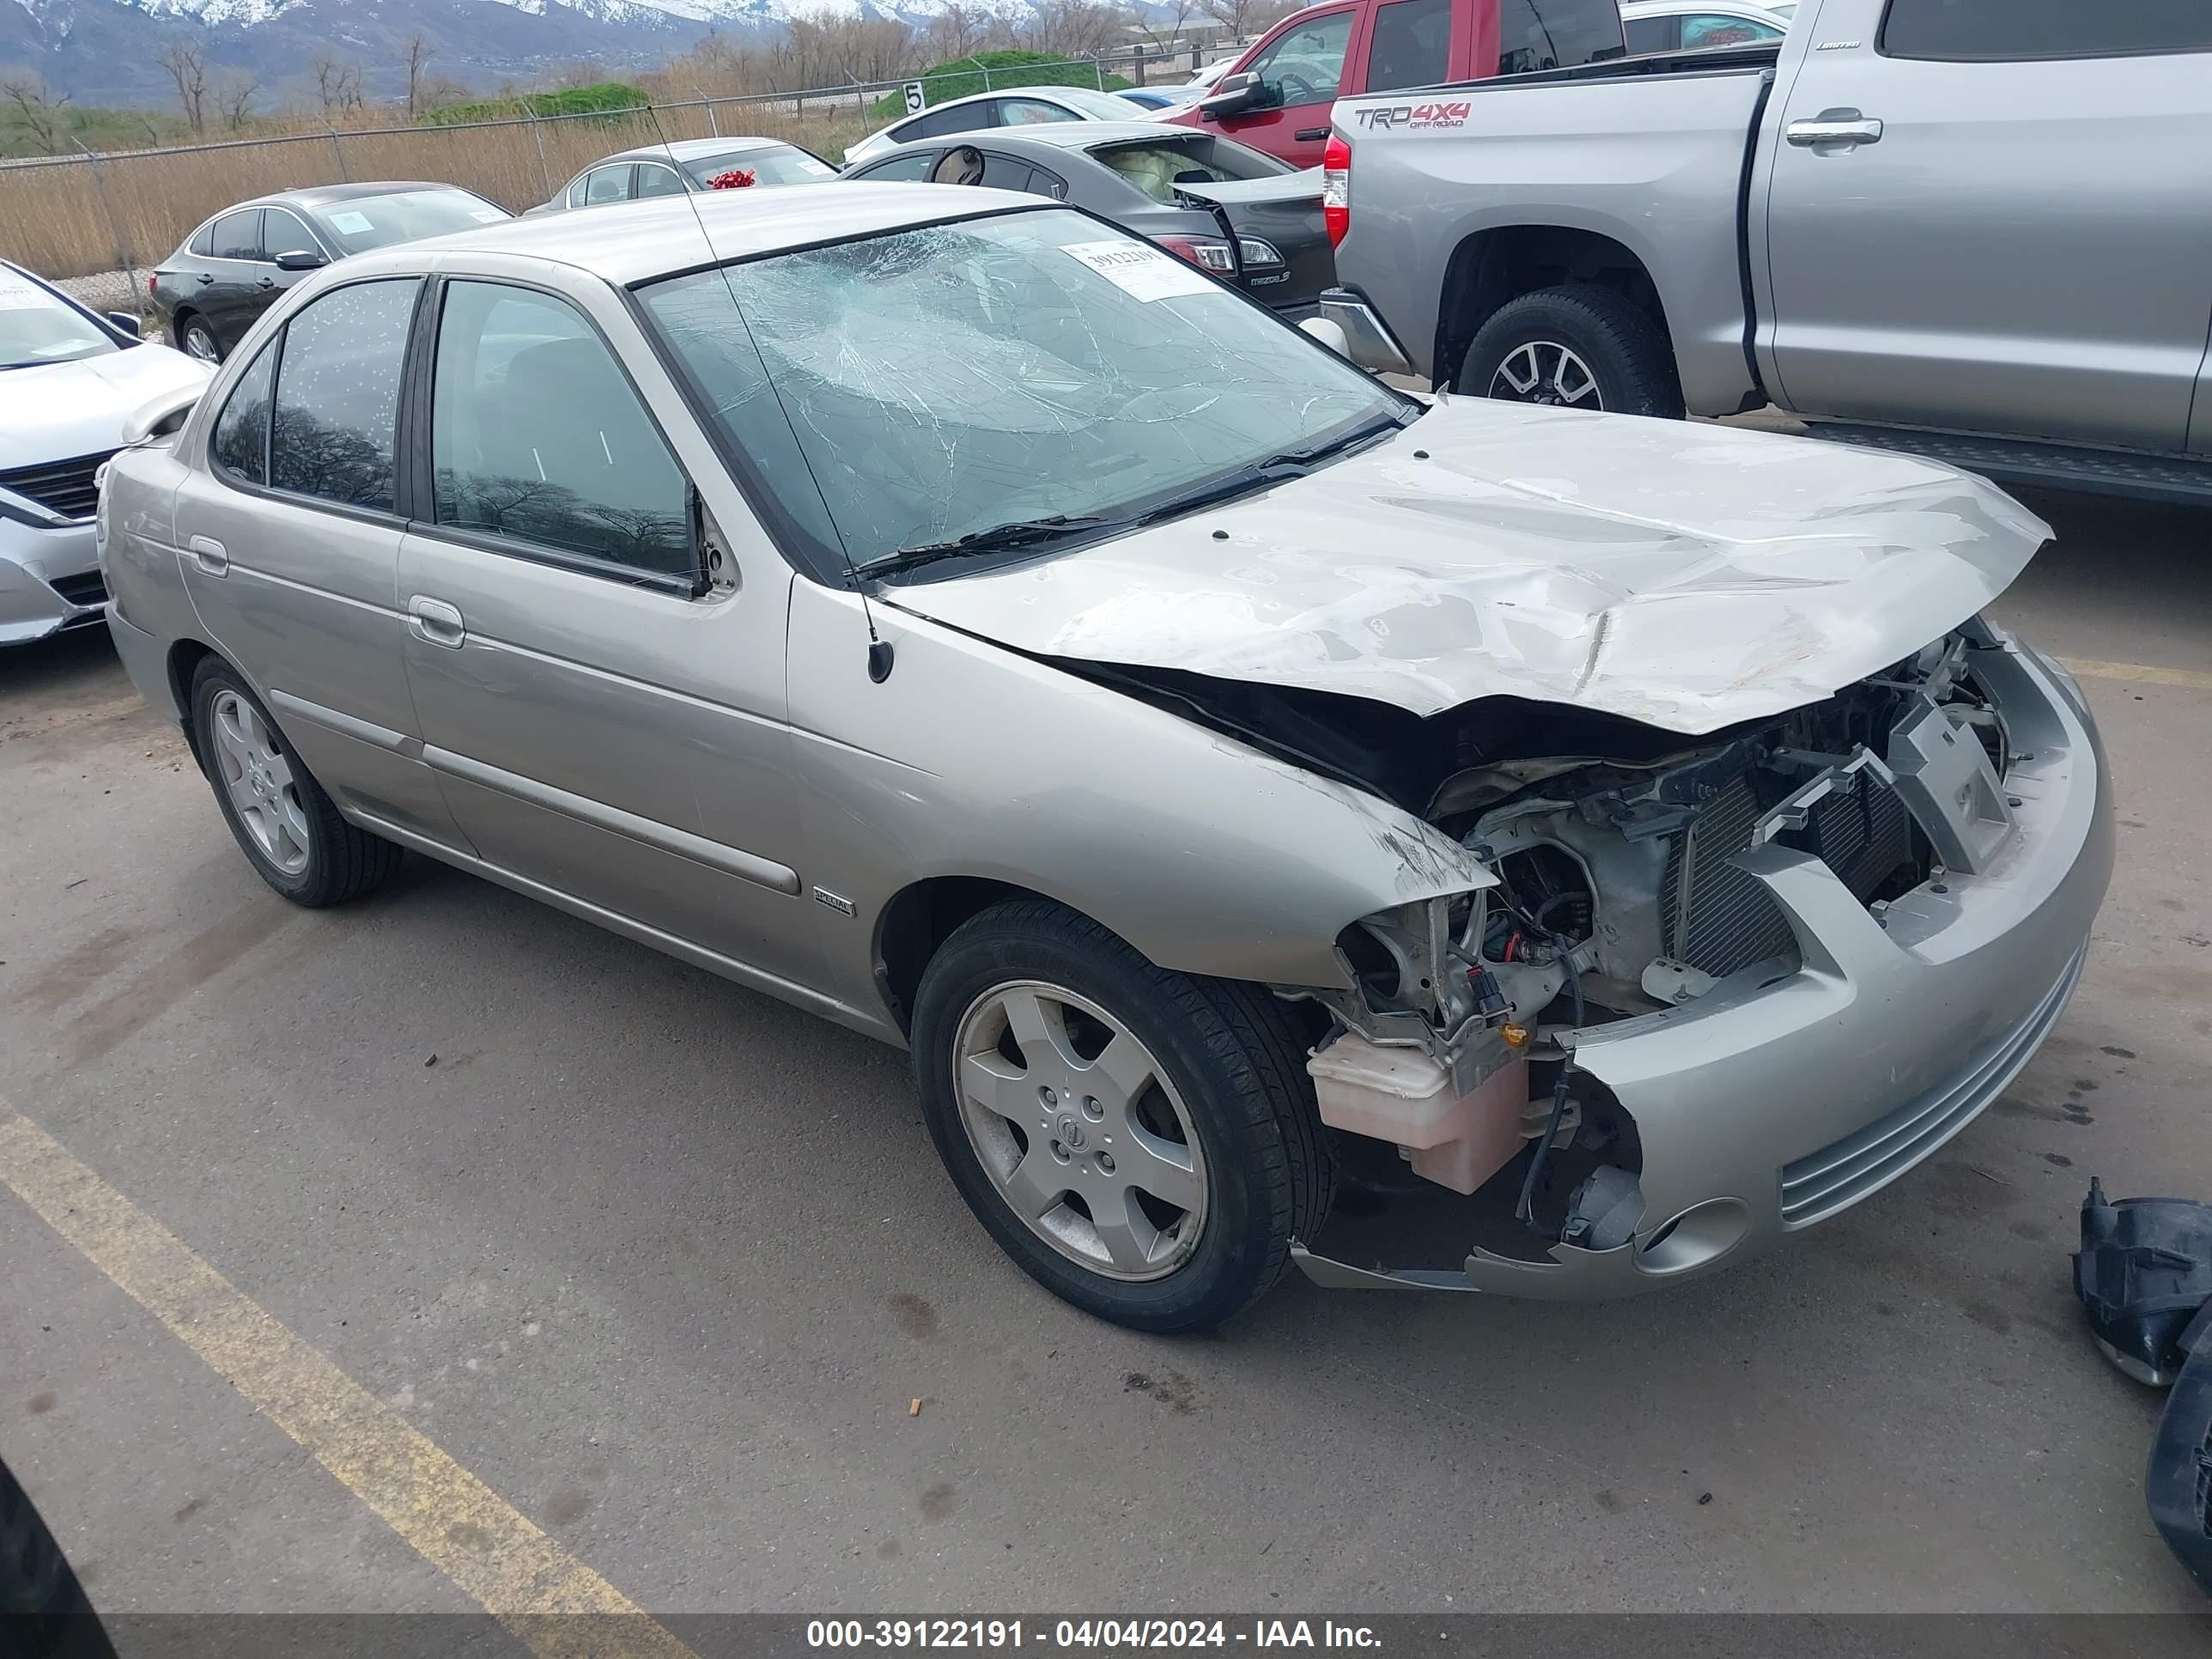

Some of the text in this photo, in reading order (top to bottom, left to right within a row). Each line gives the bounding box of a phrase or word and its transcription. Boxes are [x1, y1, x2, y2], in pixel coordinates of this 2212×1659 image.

[905, 84, 922, 110] 5
[1354, 102, 1472, 131] TRD 4X4
[1409, 119, 1464, 130] OFF ROAD
[1087, 249, 1161, 268] 39122191
